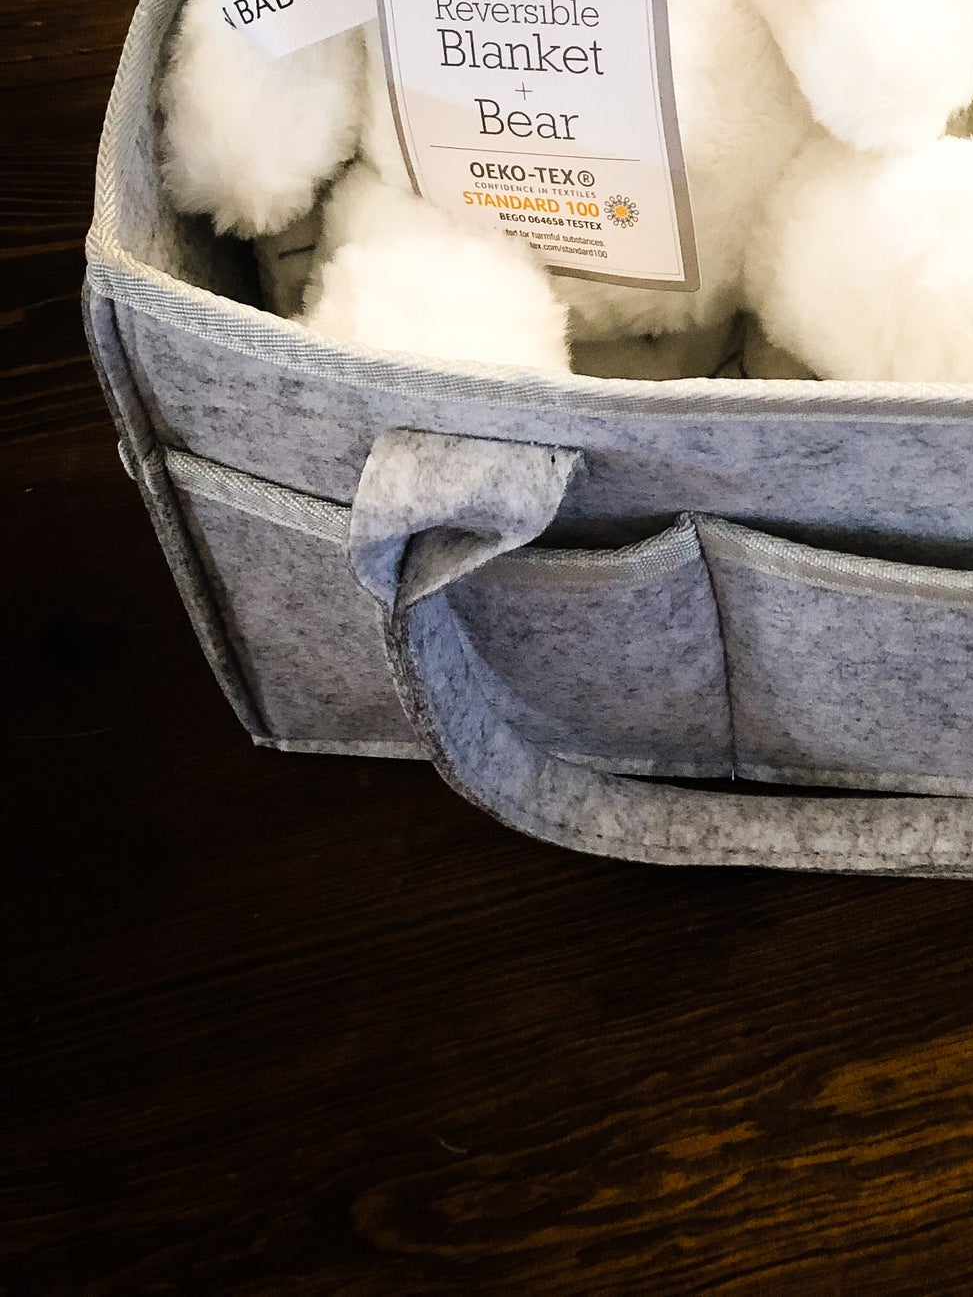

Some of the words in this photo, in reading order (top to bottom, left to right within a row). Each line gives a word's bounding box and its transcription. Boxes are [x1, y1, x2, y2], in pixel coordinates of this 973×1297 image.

[437, 28, 604, 75] Blanket
[474, 98, 579, 141] Bear
[475, 182, 534, 193] CONFIDENCE
[552, 188, 597, 199] TEXTILES
[463, 191, 560, 213] STANDARD
[566, 202, 600, 218] 100
[499, 212, 526, 223] BEGO
[566, 219, 602, 231] TESTEX
[531, 231, 561, 242] harmful
